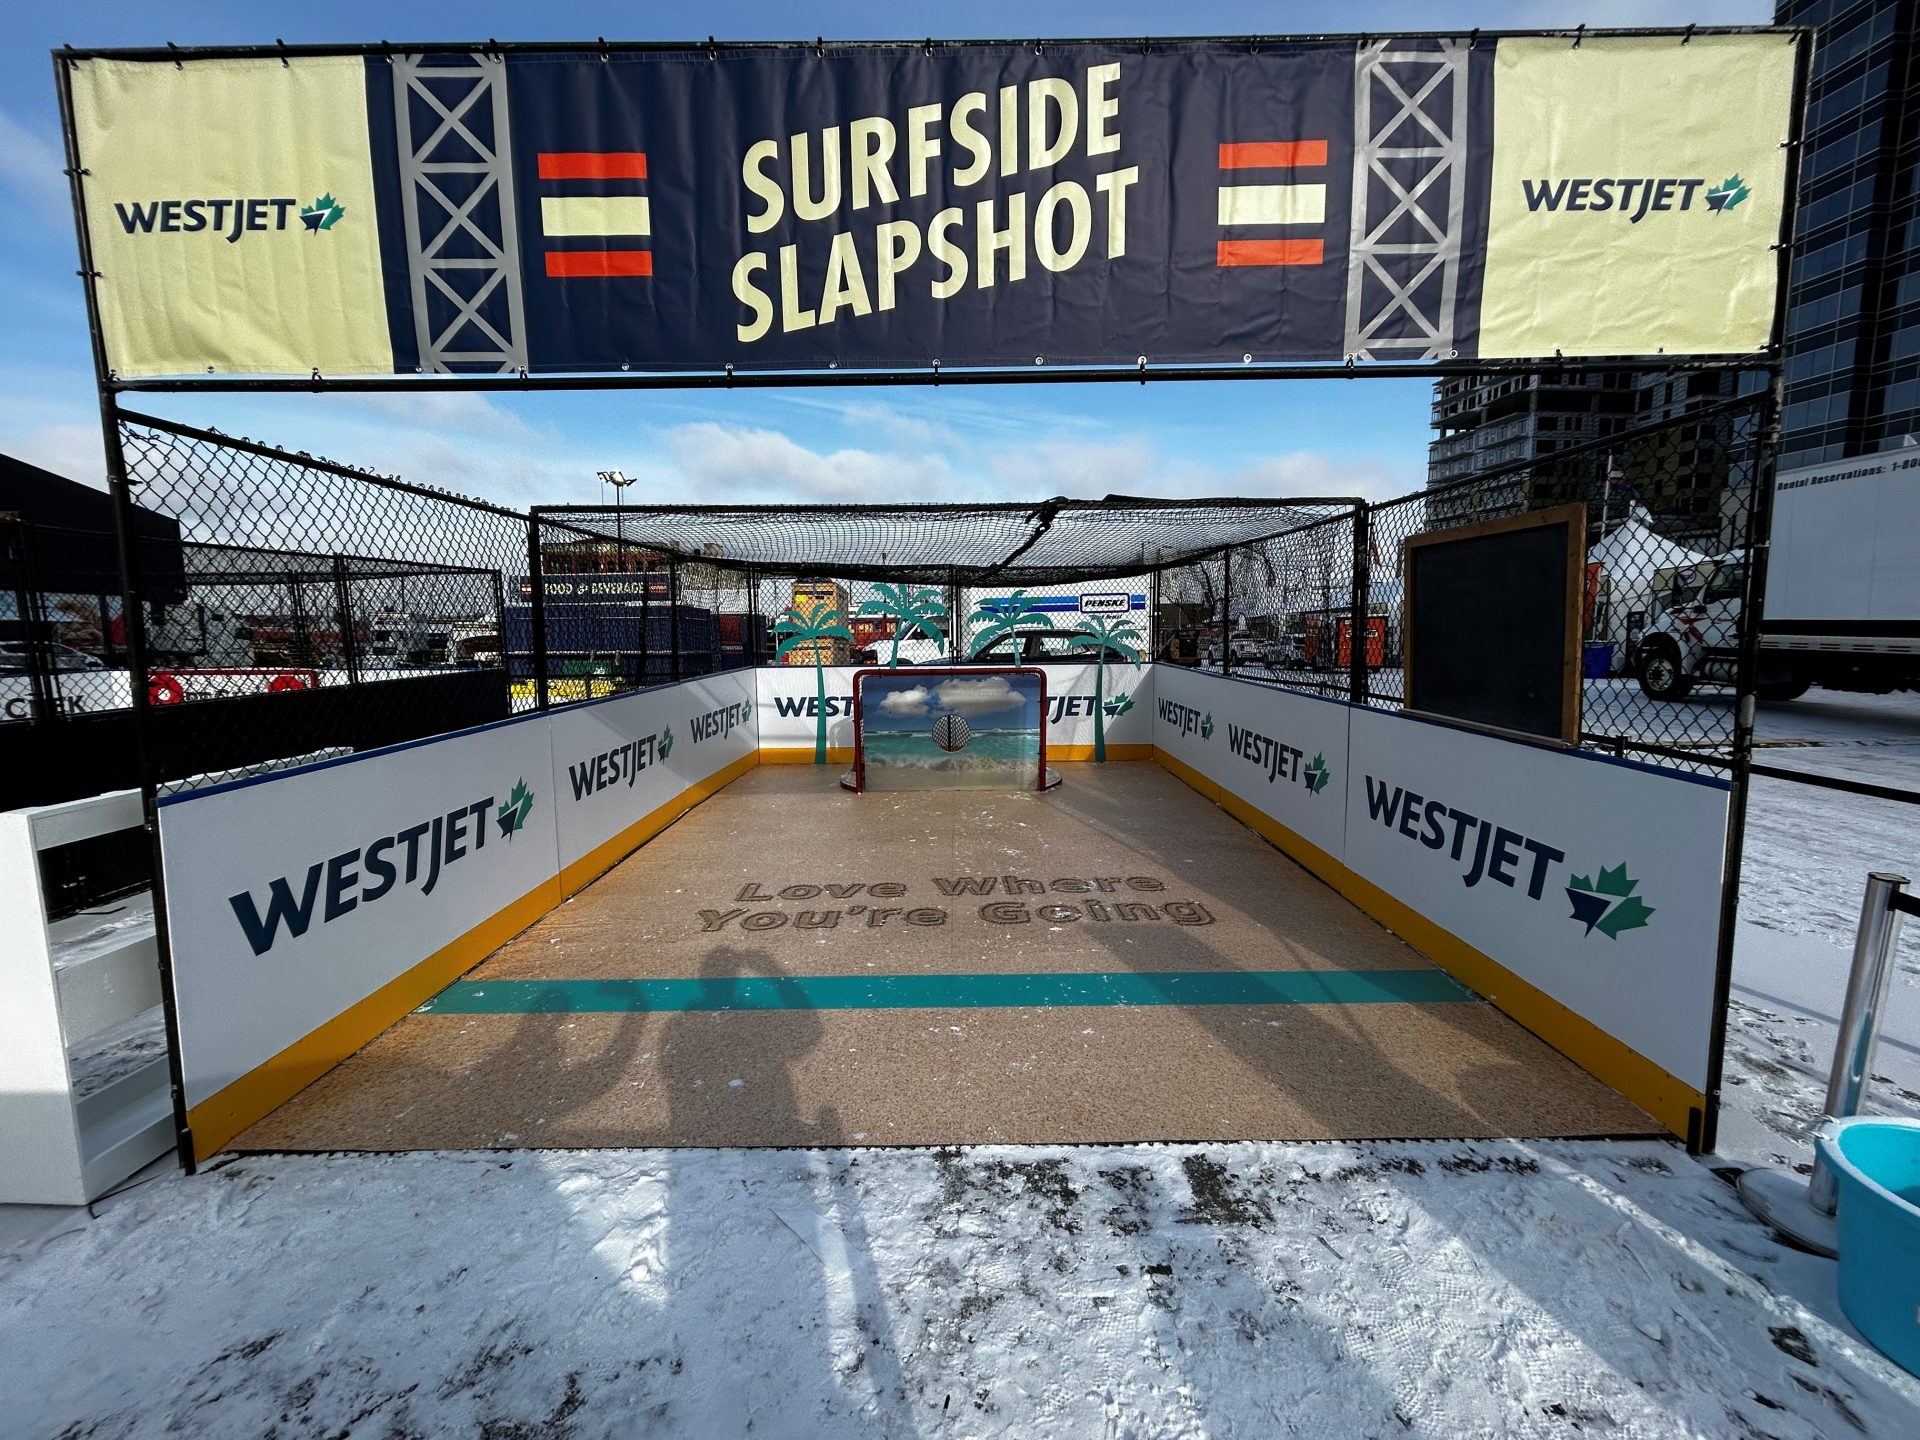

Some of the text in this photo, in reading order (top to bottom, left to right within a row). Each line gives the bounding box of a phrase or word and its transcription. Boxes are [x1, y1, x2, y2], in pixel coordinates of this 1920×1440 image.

[742, 62, 1121, 234] SURFSIDE
[115, 198, 296, 244] WESTJET
[1521, 178, 1705, 224] WESTJET
[731, 165, 1139, 343] SLAPSHOT
[1777, 478, 1809, 490] Rental
[1810, 465, 1887, 486] Reservations:
[544, 583, 573, 595] FOOD
[591, 581, 645, 595] BEVERAGE
[1084, 599, 1127, 608] PENSKE
[690, 703, 741, 744] WESTJET
[1158, 697, 1201, 738] WESTJET
[568, 733, 657, 802] WESTJET
[1228, 723, 1304, 784] WESTJET
[1365, 774, 1566, 902] WESTJET
[228, 796, 495, 957] WESTJET
[734, 882, 908, 902] Love
[699, 899, 1216, 932] You're Going
